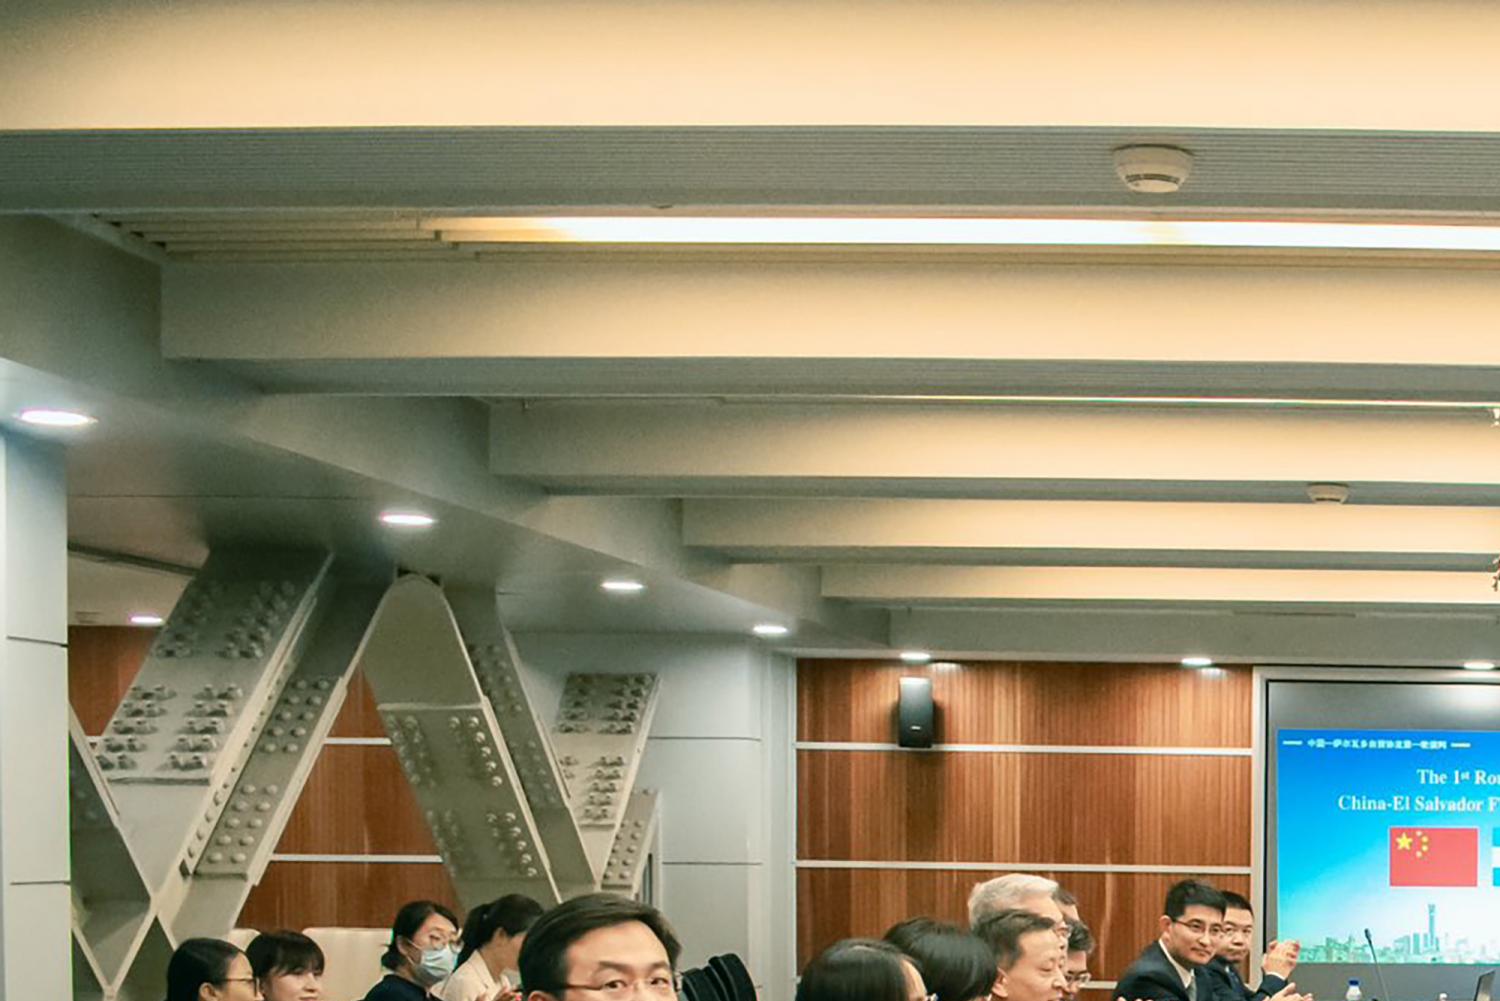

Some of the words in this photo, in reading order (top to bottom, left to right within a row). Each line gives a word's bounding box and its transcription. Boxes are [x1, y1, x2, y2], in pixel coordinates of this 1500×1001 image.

[1417, 770, 1447, 785] The
[1454, 770, 1470, 785] 1st
[1338, 795, 1411, 811] China-El
[1415, 796, 1483, 812] Salvador
